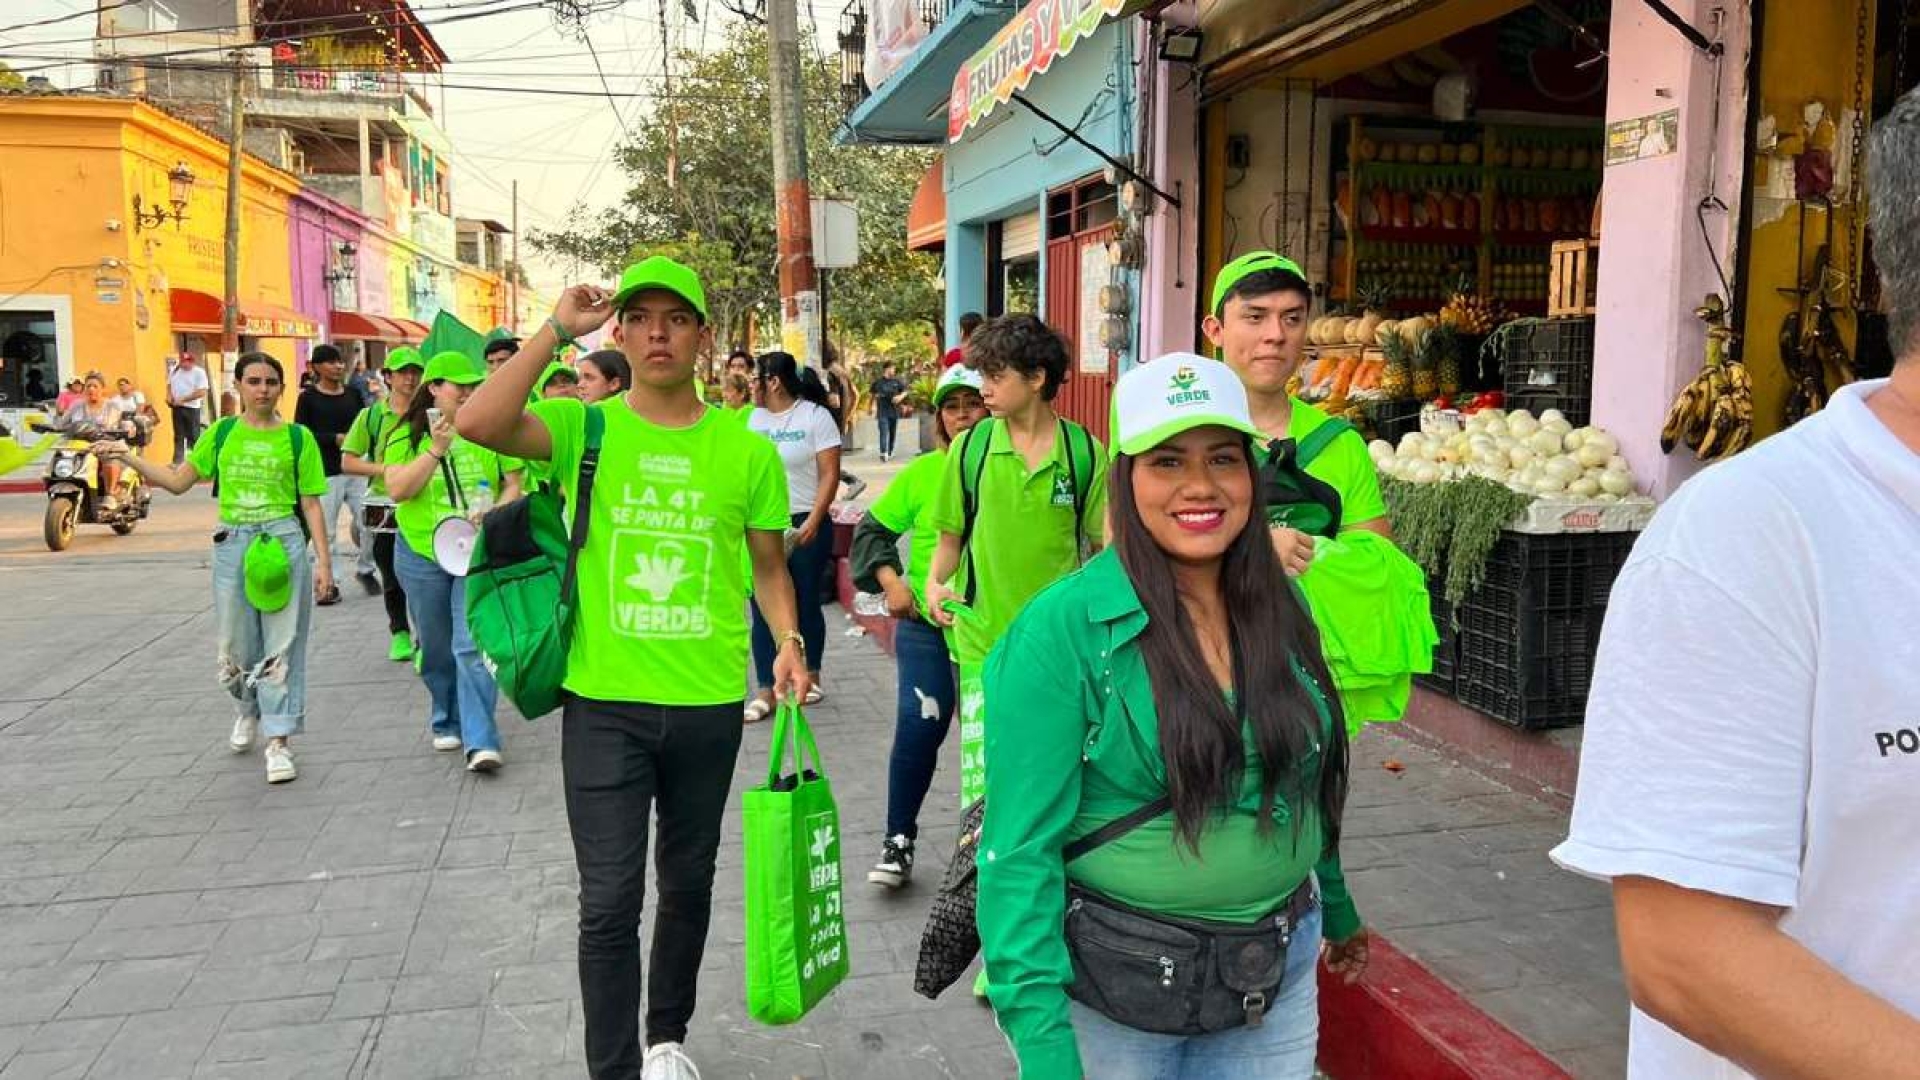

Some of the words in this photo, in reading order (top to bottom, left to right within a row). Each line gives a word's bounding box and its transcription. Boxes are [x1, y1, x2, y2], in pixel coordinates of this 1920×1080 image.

[969, 18, 1035, 104] FRUTAS
[1037, 0, 1055, 46] Y
[1166, 389, 1212, 405] VERDE
[624, 483, 660, 506] LA
[668, 488, 705, 511] 4T
[611, 505, 632, 524] SE
[635, 507, 687, 529] PINTA
[691, 514, 717, 531] DE
[617, 602, 705, 632] VERDE
[1874, 725, 1920, 758] PO
